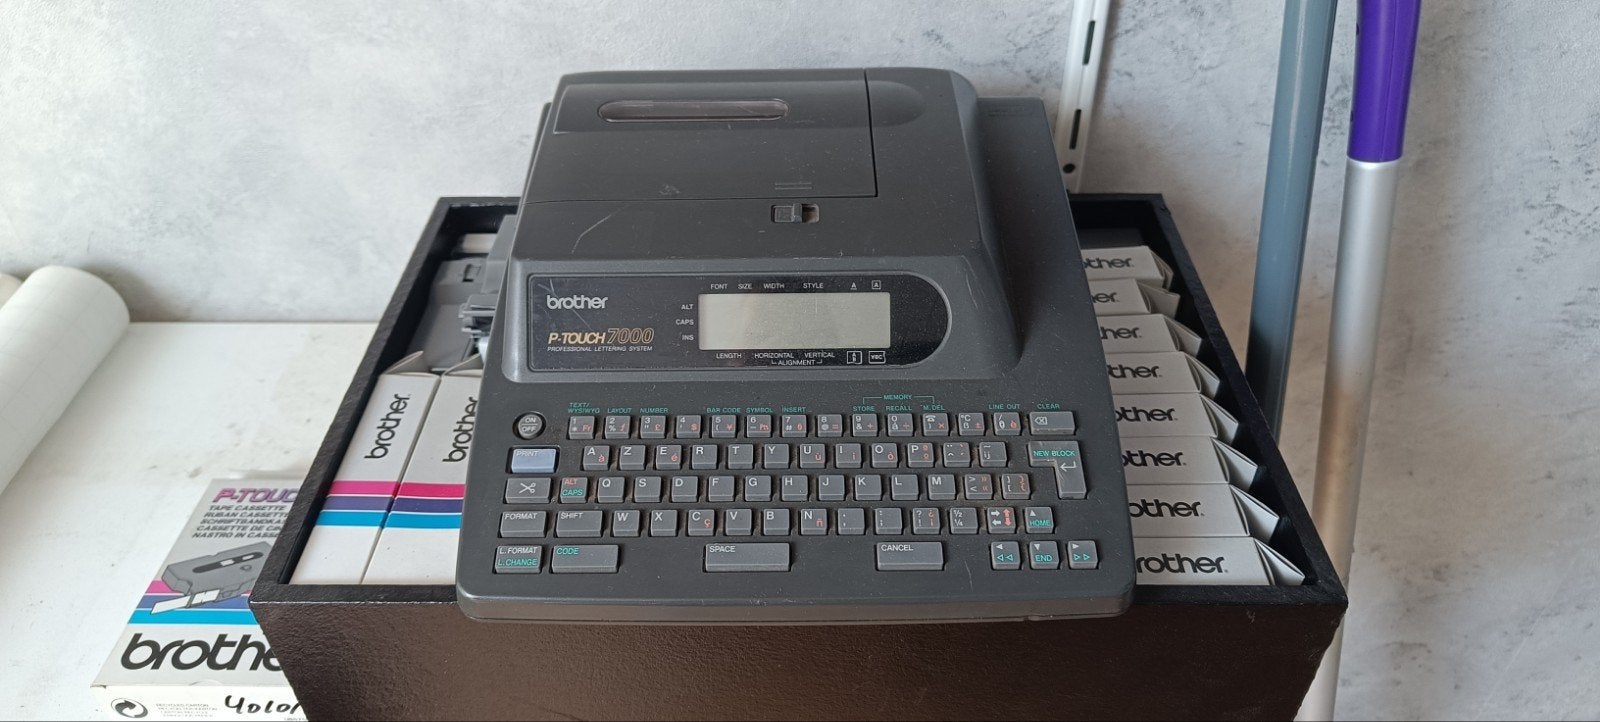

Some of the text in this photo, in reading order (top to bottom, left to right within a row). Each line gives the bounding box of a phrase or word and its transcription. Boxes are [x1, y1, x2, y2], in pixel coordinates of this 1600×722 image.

[1083, 258, 1132, 268] ther
[546, 295, 608, 309] brother
[548, 328, 654, 344] P-TOUCH 7000
[1107, 365, 1159, 378] ther
[364, 393, 410, 459] brother
[587, 447, 596, 455] A
[623, 447, 632, 455] Z
[660, 446, 667, 455] E
[696, 447, 704, 455] R
[732, 446, 740, 454] T
[768, 446, 776, 454] Y
[803, 446, 812, 454] U
[875, 445, 884, 453] O
[911, 445, 919, 453] P
[602, 479, 611, 488] Q
[638, 478, 647, 488] S
[675, 479, 684, 487] D
[712, 478, 720, 486] F
[748, 478, 757, 487] G
[784, 477, 793, 487] H
[822, 477, 829, 486] J
[858, 477, 866, 486] K
[895, 477, 902, 486] L
[932, 477, 942, 485] M
[212, 488, 299, 503] P-TOUC
[617, 512, 629, 521] W
[655, 512, 663, 521] X
[692, 512, 701, 521] C
[730, 511, 738, 520] V
[766, 511, 774, 520] B
[804, 511, 812, 520] N
[121, 633, 283, 671] brothe
